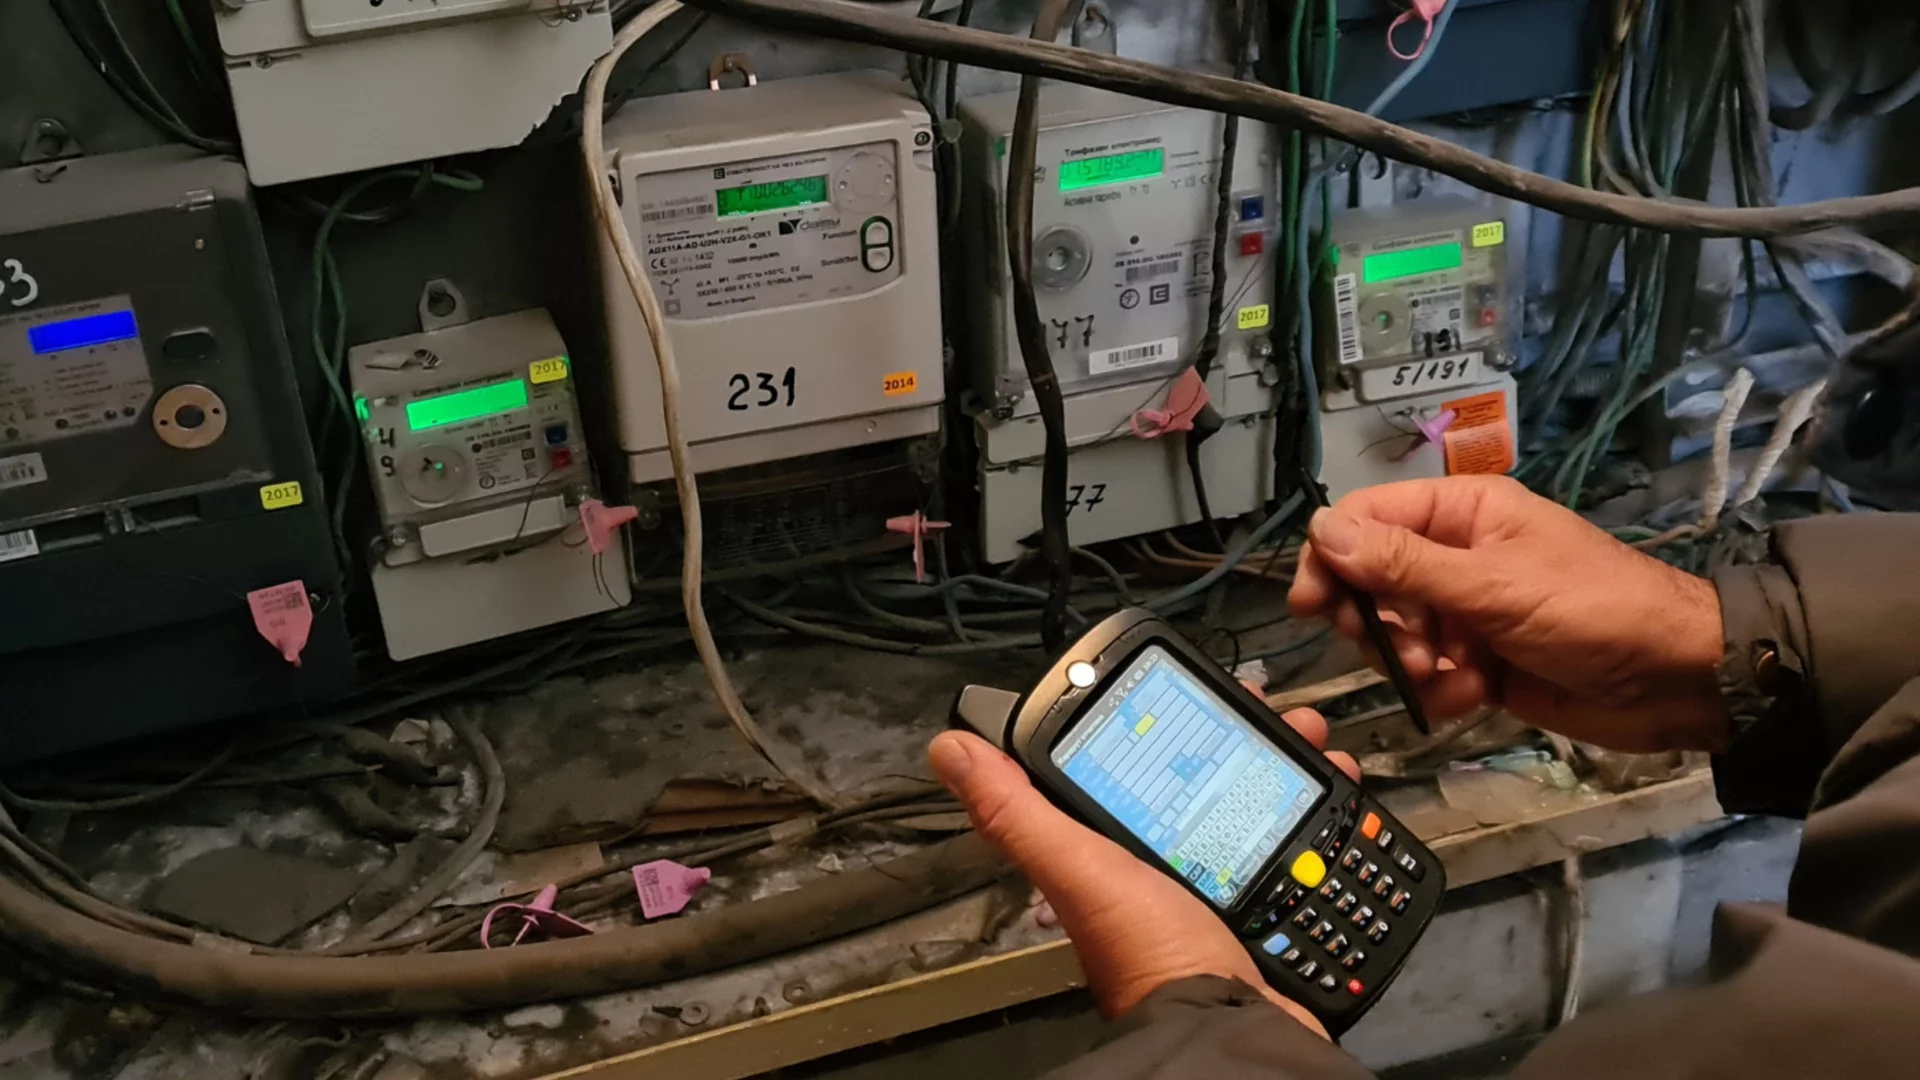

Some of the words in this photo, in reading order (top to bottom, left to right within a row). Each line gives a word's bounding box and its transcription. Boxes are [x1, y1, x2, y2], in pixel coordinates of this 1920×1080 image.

[1475, 225, 1501, 238] 2017
[0, 258, 38, 306] 3
[1240, 308, 1267, 323] 2017
[535, 360, 567, 376] 2017
[1393, 357, 1470, 386] 5/191
[728, 366, 796, 411] 231
[884, 375, 915, 392] 2014
[264, 484, 300, 502] 2017
[1066, 483, 1107, 518] 77
